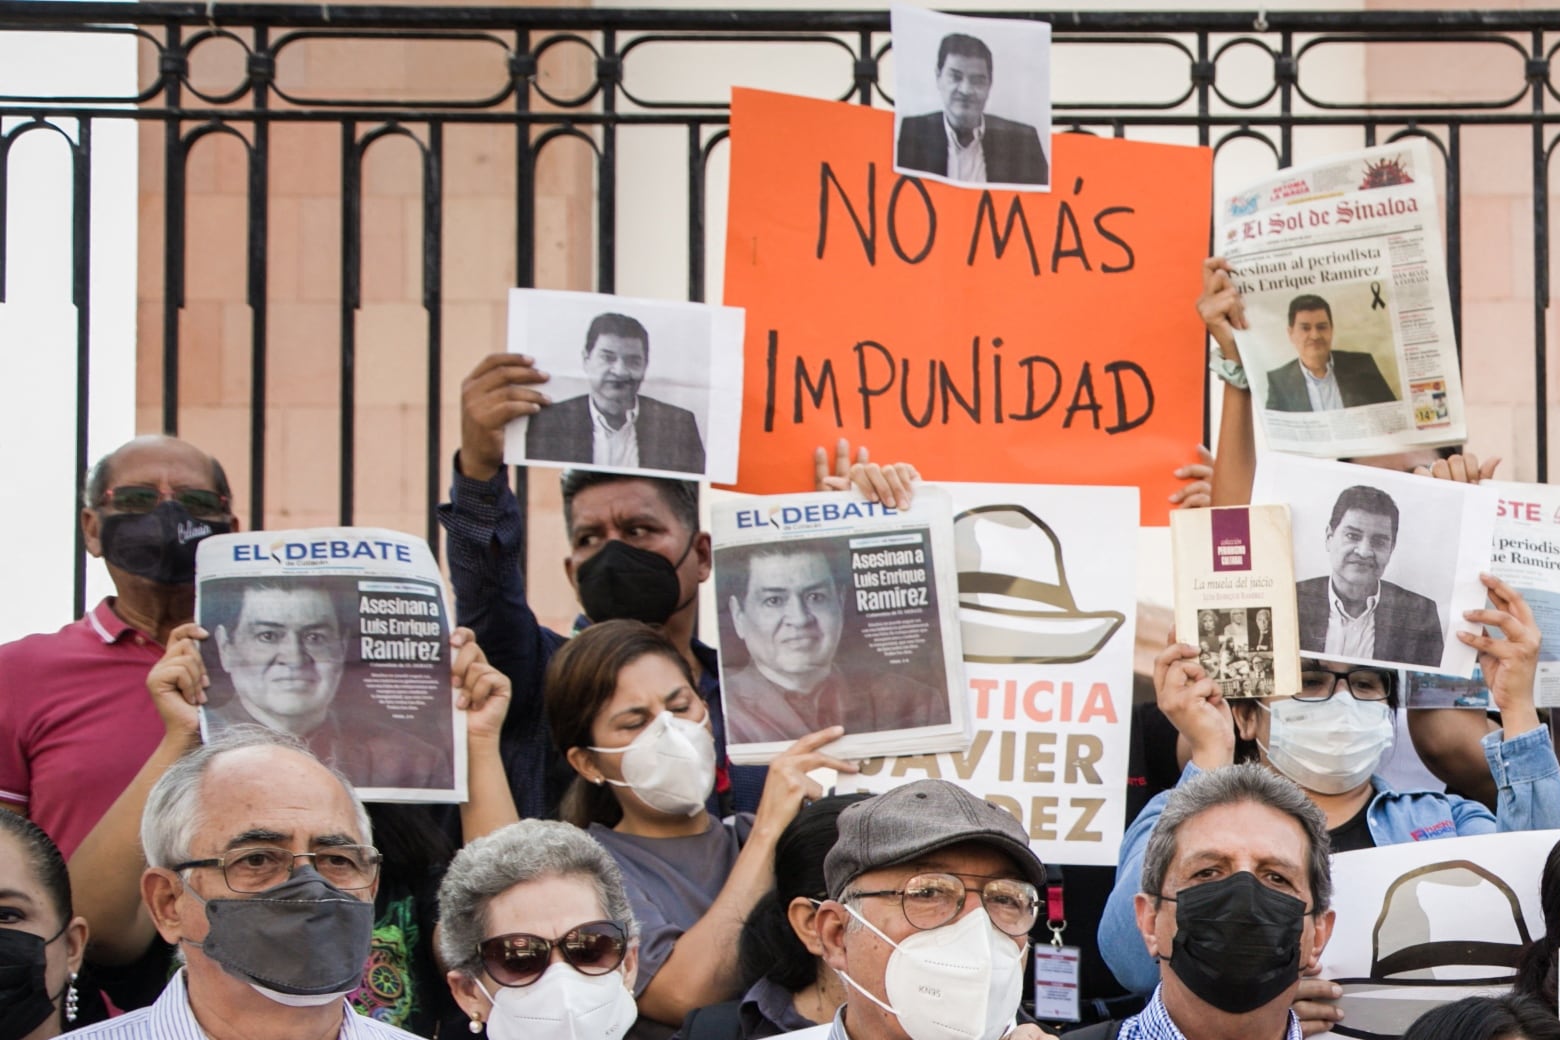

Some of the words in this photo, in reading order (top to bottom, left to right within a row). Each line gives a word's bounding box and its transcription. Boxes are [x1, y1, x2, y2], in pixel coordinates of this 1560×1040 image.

[816, 162, 937, 265] NO
[968, 177, 1135, 276] MÁS
[1242, 218, 1262, 239] El
[1267, 213, 1304, 235] Sol
[1308, 208, 1330, 226] de
[1335, 198, 1418, 223] Sinaloa
[1292, 257, 1304, 270] al
[1309, 248, 1381, 270] periodista
[1260, 272, 1316, 294] Enrique
[1320, 265, 1379, 285] Ramírez
[736, 510, 770, 528] EL
[782, 502, 898, 525] DEBATE
[233, 545, 270, 561] EL
[285, 540, 412, 563] DEBATE
[852, 550, 914, 569] Asesinan
[916, 549, 924, 563] a
[854, 571, 878, 588] Luis
[880, 569, 926, 586] Enrique
[360, 596, 428, 615] Asesinan
[429, 602, 439, 616] a
[360, 618, 388, 634] Luis
[390, 619, 440, 637] Enrique
[970, 678, 1118, 724] TICIA
